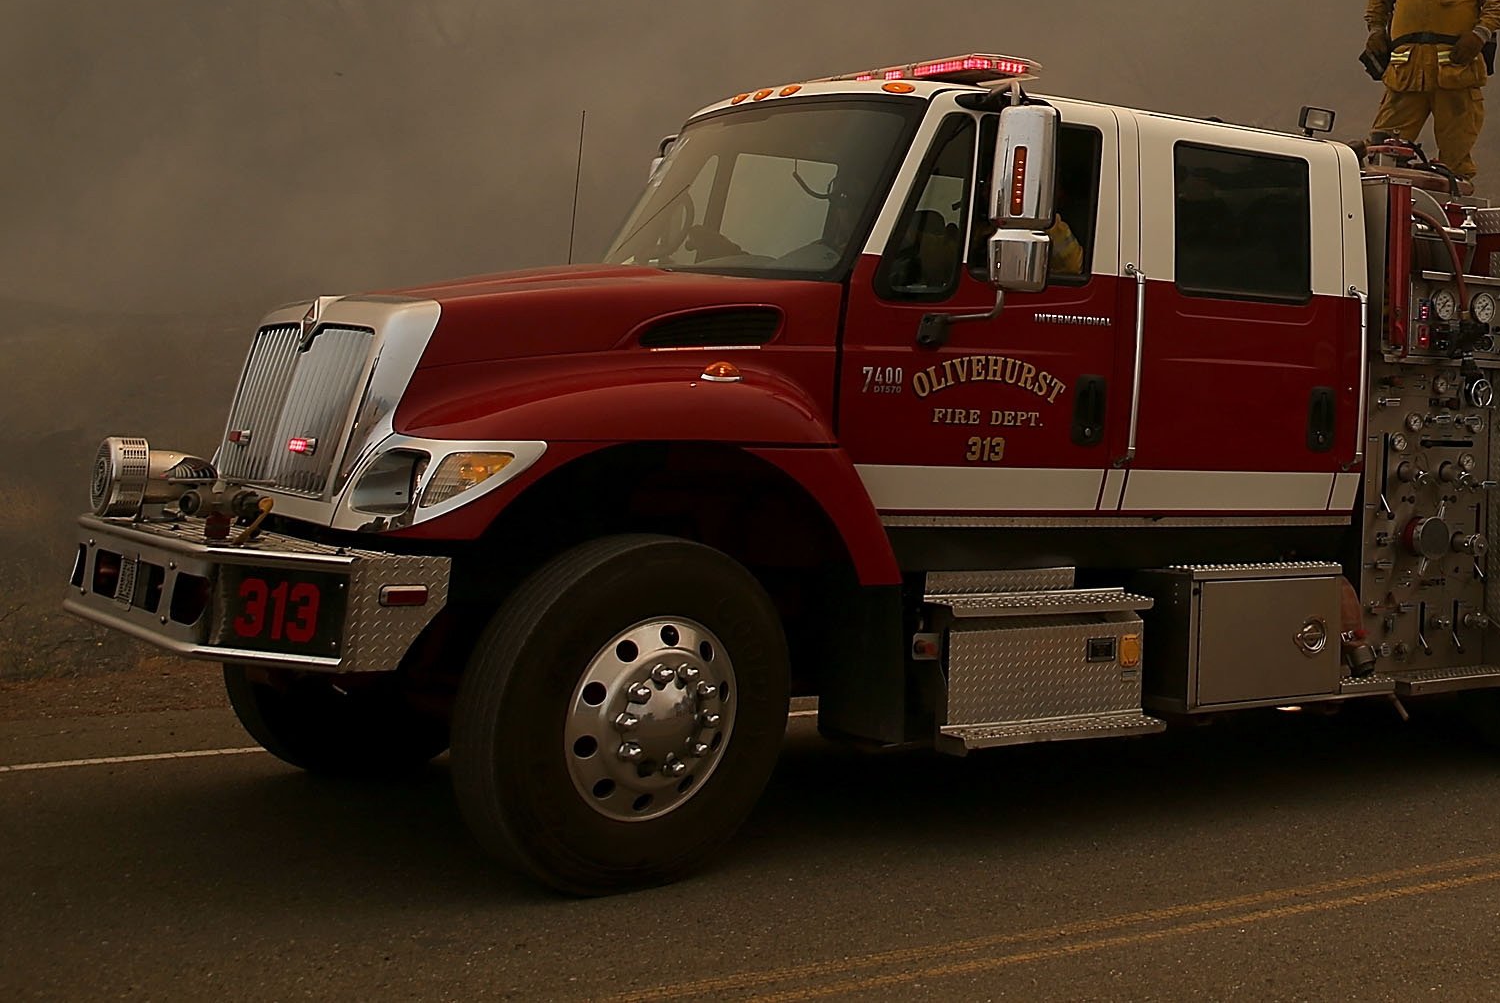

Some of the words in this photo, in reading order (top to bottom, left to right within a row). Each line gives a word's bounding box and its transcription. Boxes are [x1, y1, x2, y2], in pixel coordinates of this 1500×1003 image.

[1034, 313, 1112, 326] INTERNATIONAL
[862, 366, 903, 393] 7400
[912, 355, 1067, 404] OLIVEHURST
[932, 408, 980, 424] FIRE
[990, 410, 1044, 427] DEPT.
[966, 436, 1006, 461] 313
[232, 578, 321, 643] 313
